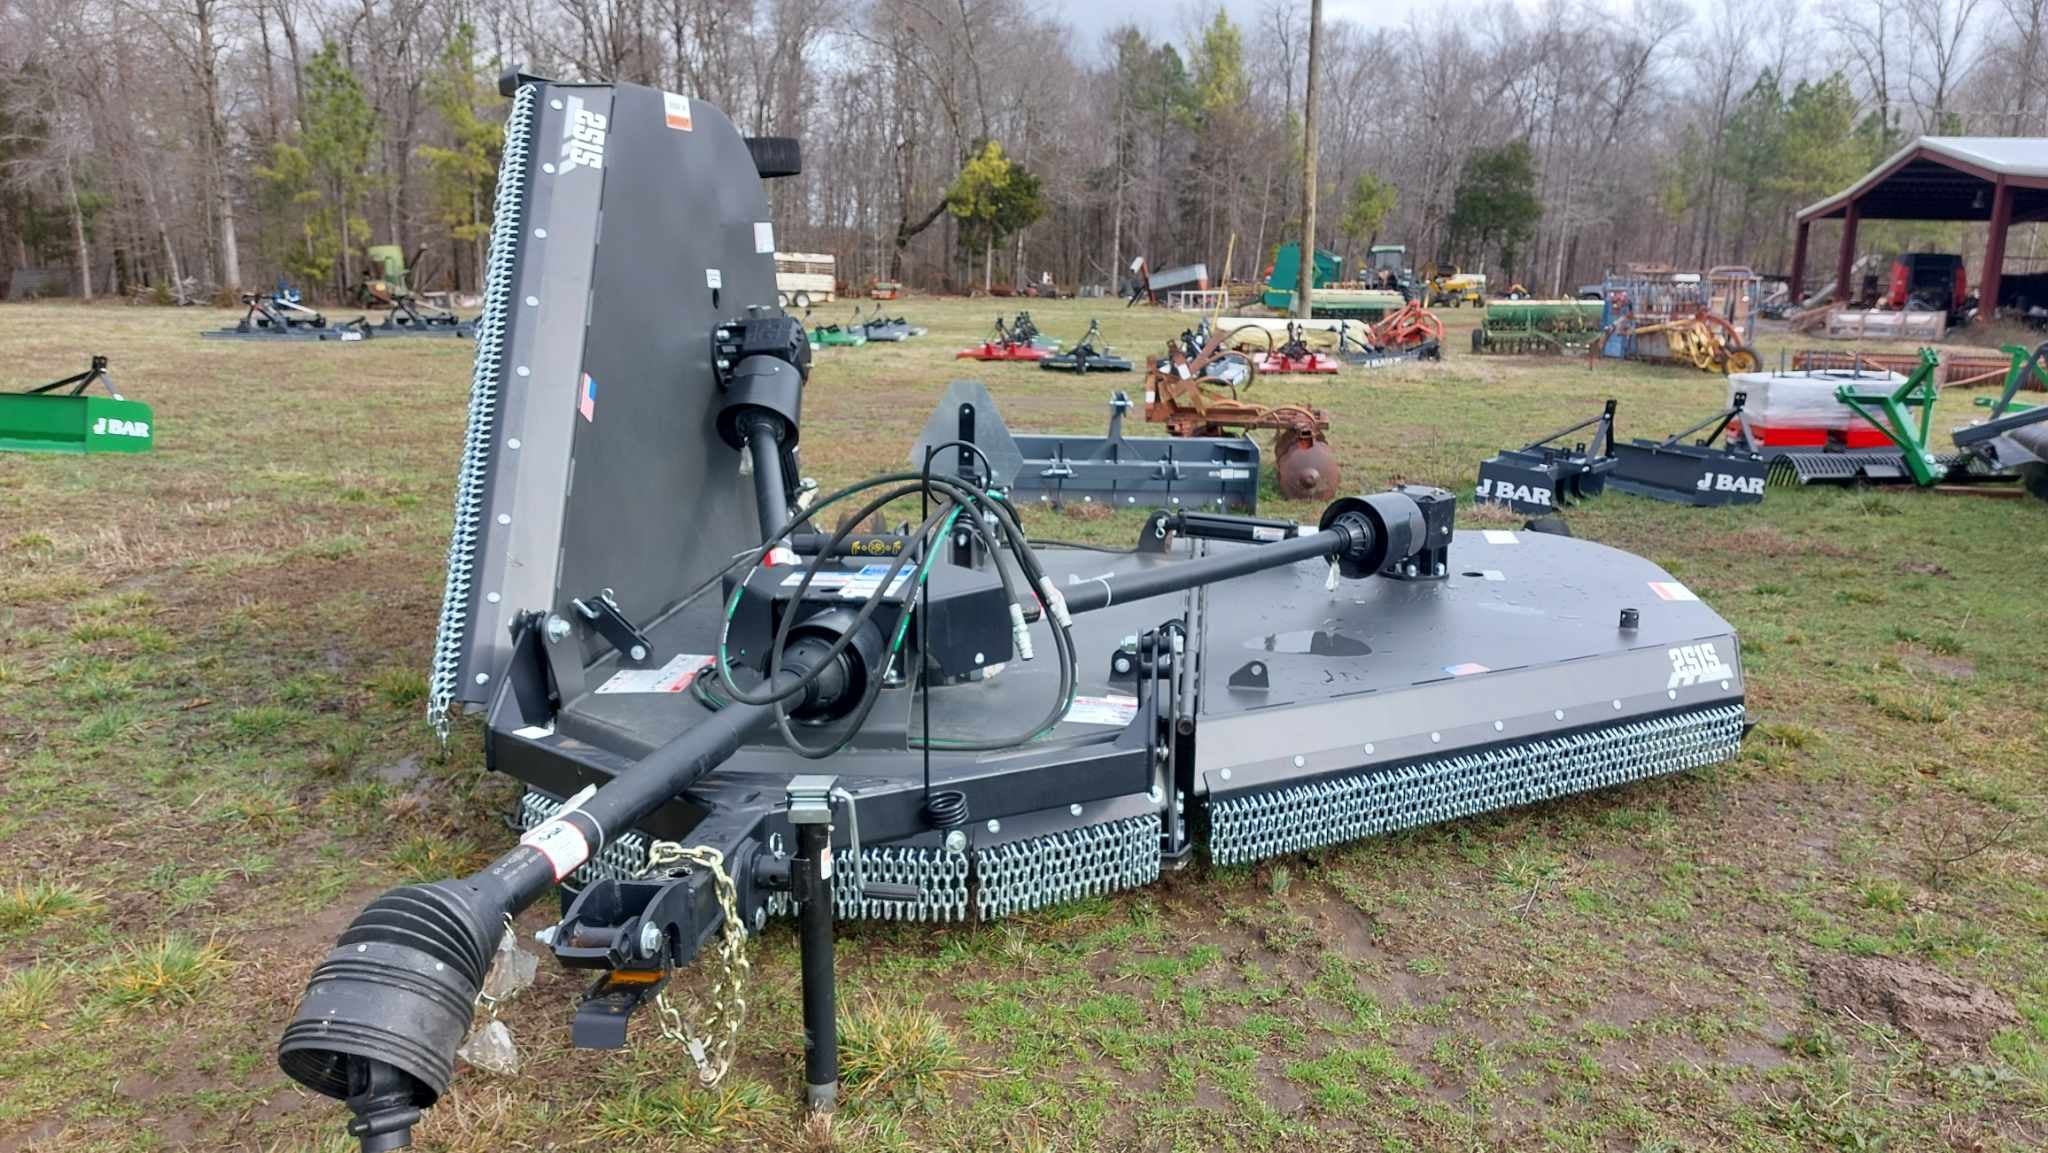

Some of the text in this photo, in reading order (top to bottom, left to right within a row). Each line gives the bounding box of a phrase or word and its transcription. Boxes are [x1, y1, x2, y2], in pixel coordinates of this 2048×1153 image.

[568, 108, 607, 169] 2515
[93, 417, 149, 438] J BAR
[1475, 478, 1552, 506] J BAR
[1697, 471, 1765, 494] J BAR
[1667, 643, 1722, 678] 2515
